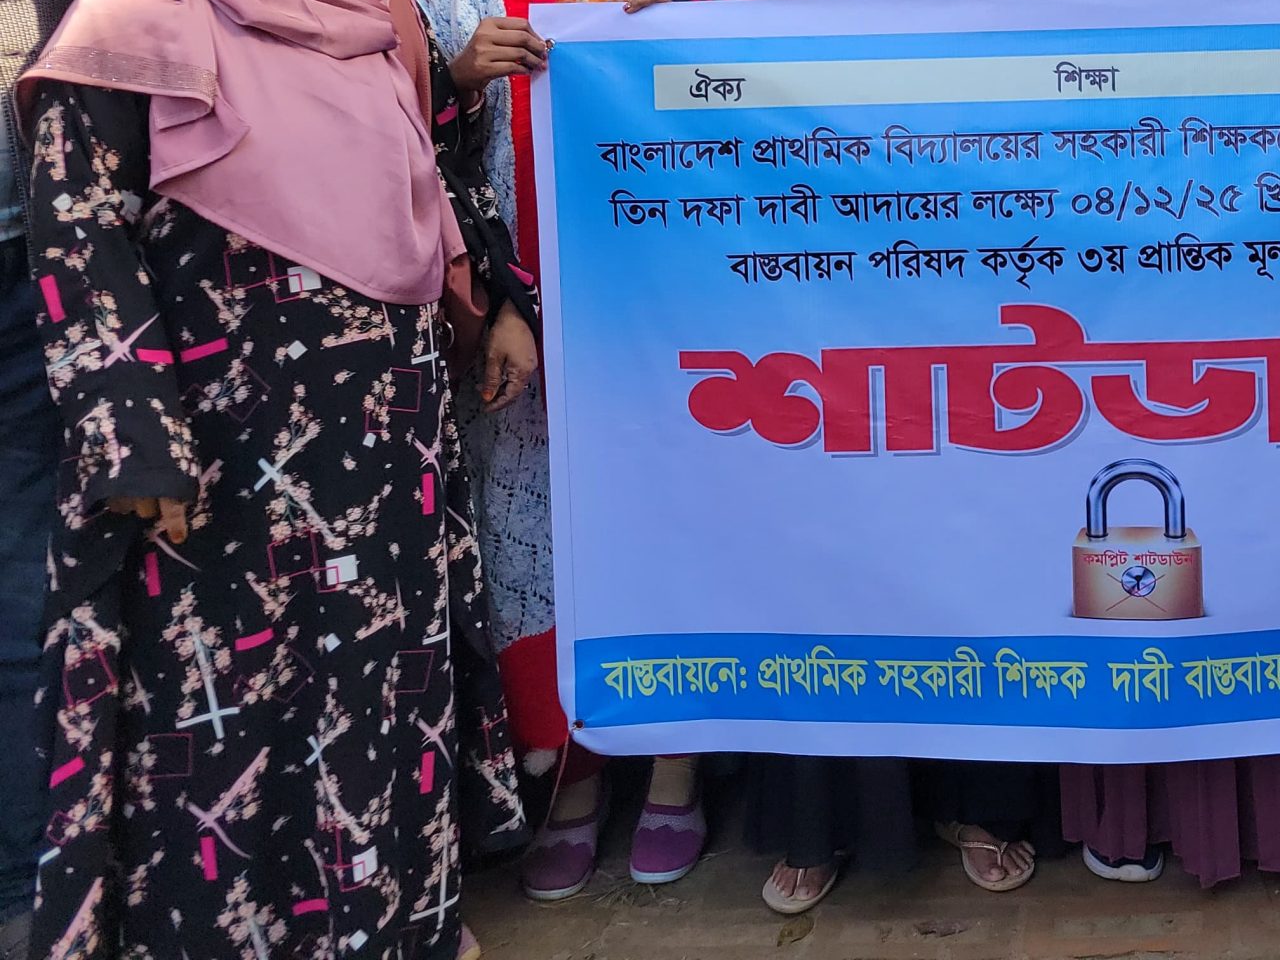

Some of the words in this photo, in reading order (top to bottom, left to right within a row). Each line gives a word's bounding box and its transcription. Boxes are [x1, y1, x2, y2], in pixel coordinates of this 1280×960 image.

[689, 68, 746, 102] ঐক্য
[1054, 62, 1120, 92] শিক্ষা
[597, 136, 742, 175] বাংলাদেশ
[753, 126, 872, 169] প্রাথমিক
[881, 124, 1044, 165] বিদ্যালয়ের
[1051, 116, 1170, 161] সহকারী
[608, 189, 671, 228] তিন
[678, 194, 746, 227] দফা
[753, 183, 822, 225] দাবী
[833, 189, 962, 221] আদায়ের
[971, 189, 1059, 219] লক্ষ্যে
[1071, 179, 1244, 221] ০৪/১২/২৫
[727, 246, 857, 285] বাস্তবায়ন
[869, 242, 967, 281] পরিষদ
[979, 237, 1066, 290] কর্তৃক
[1078, 243, 1129, 275] ৩য়
[1138, 232, 1234, 274] প্রান্তিক
[1134, 550, 1193, 567] শাটডাউন
[600, 653, 748, 700] বাস্তবায়নে:
[757, 645, 869, 698] প্রাথমিক
[875, 646, 986, 700] সহকারী
[992, 648, 1089, 700] শিক্ষক
[1107, 646, 1174, 706] দাবী
